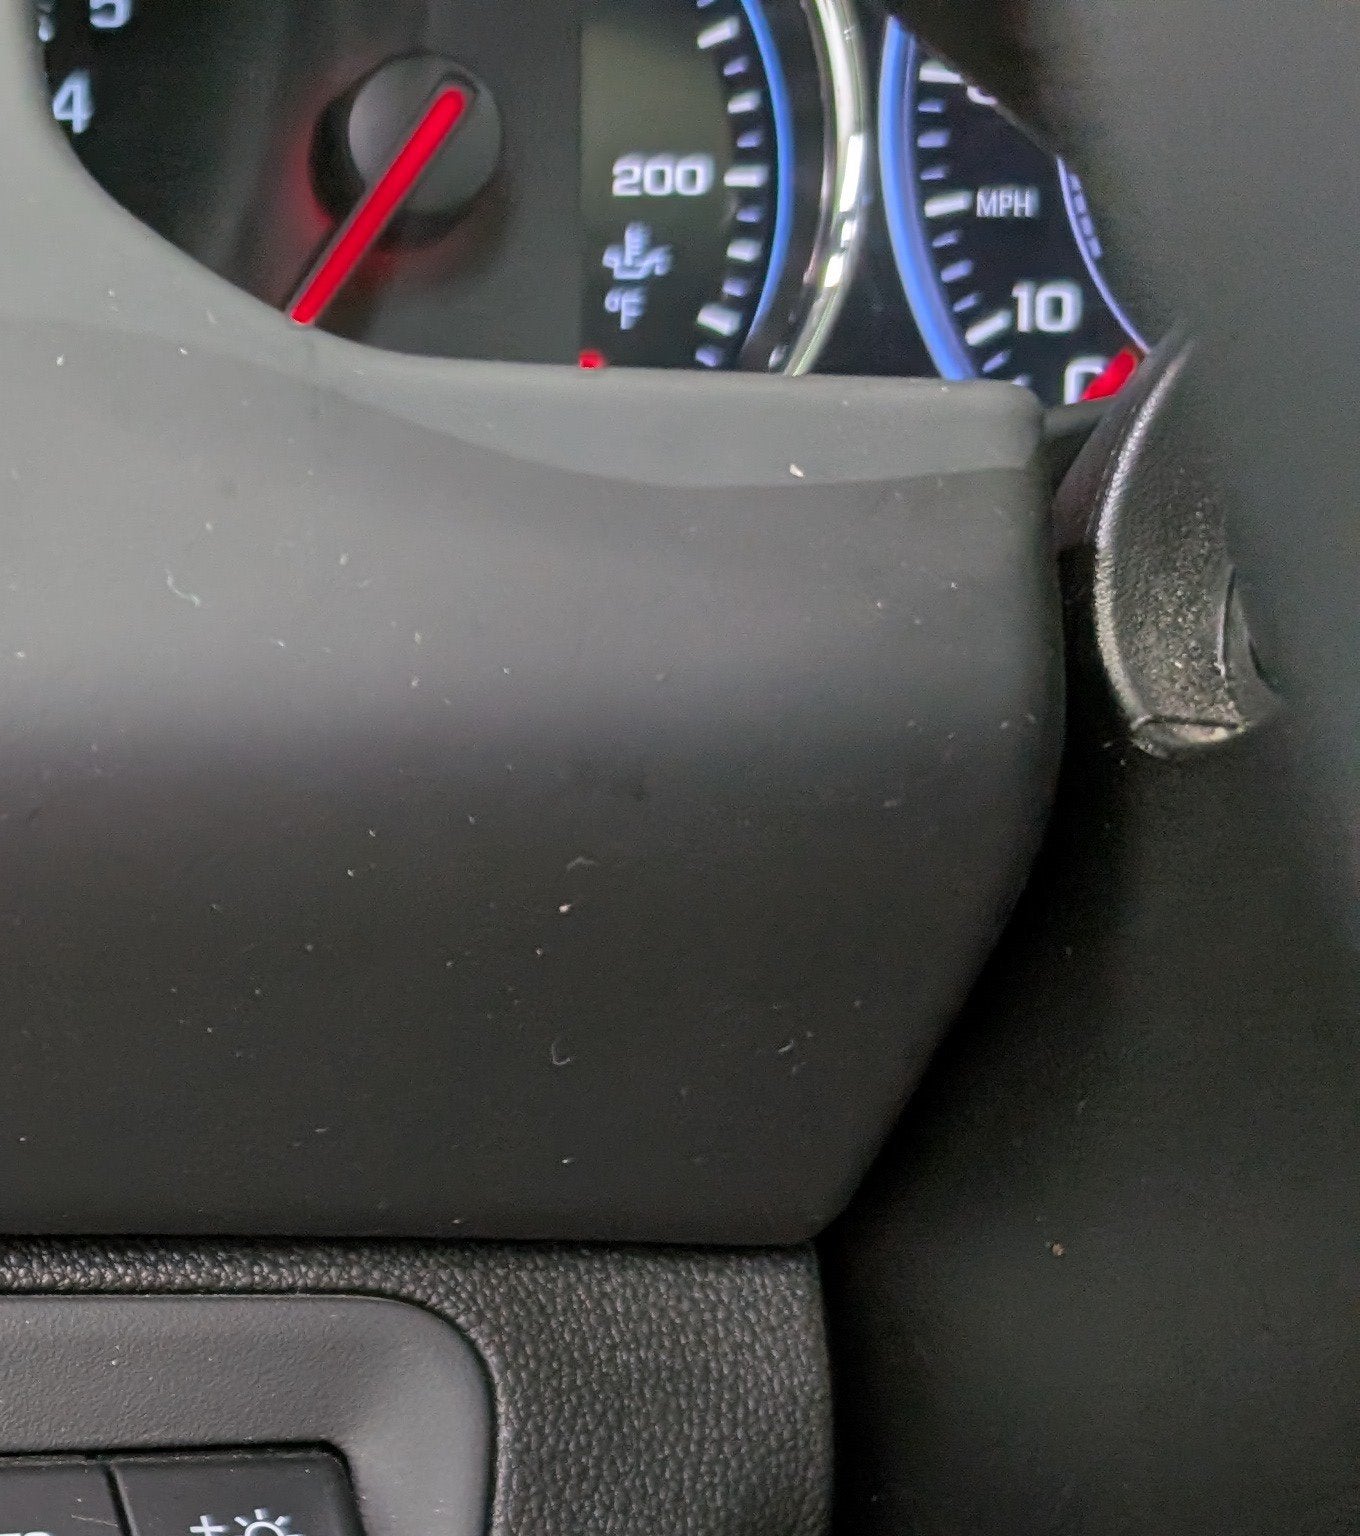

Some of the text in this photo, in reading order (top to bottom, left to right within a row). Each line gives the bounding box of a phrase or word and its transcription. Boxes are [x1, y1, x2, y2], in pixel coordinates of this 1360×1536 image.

[52, 67, 93, 133] 4
[612, 154, 715, 196] 200
[976, 186, 1037, 218] MPH
[1011, 282, 1082, 332] 10
